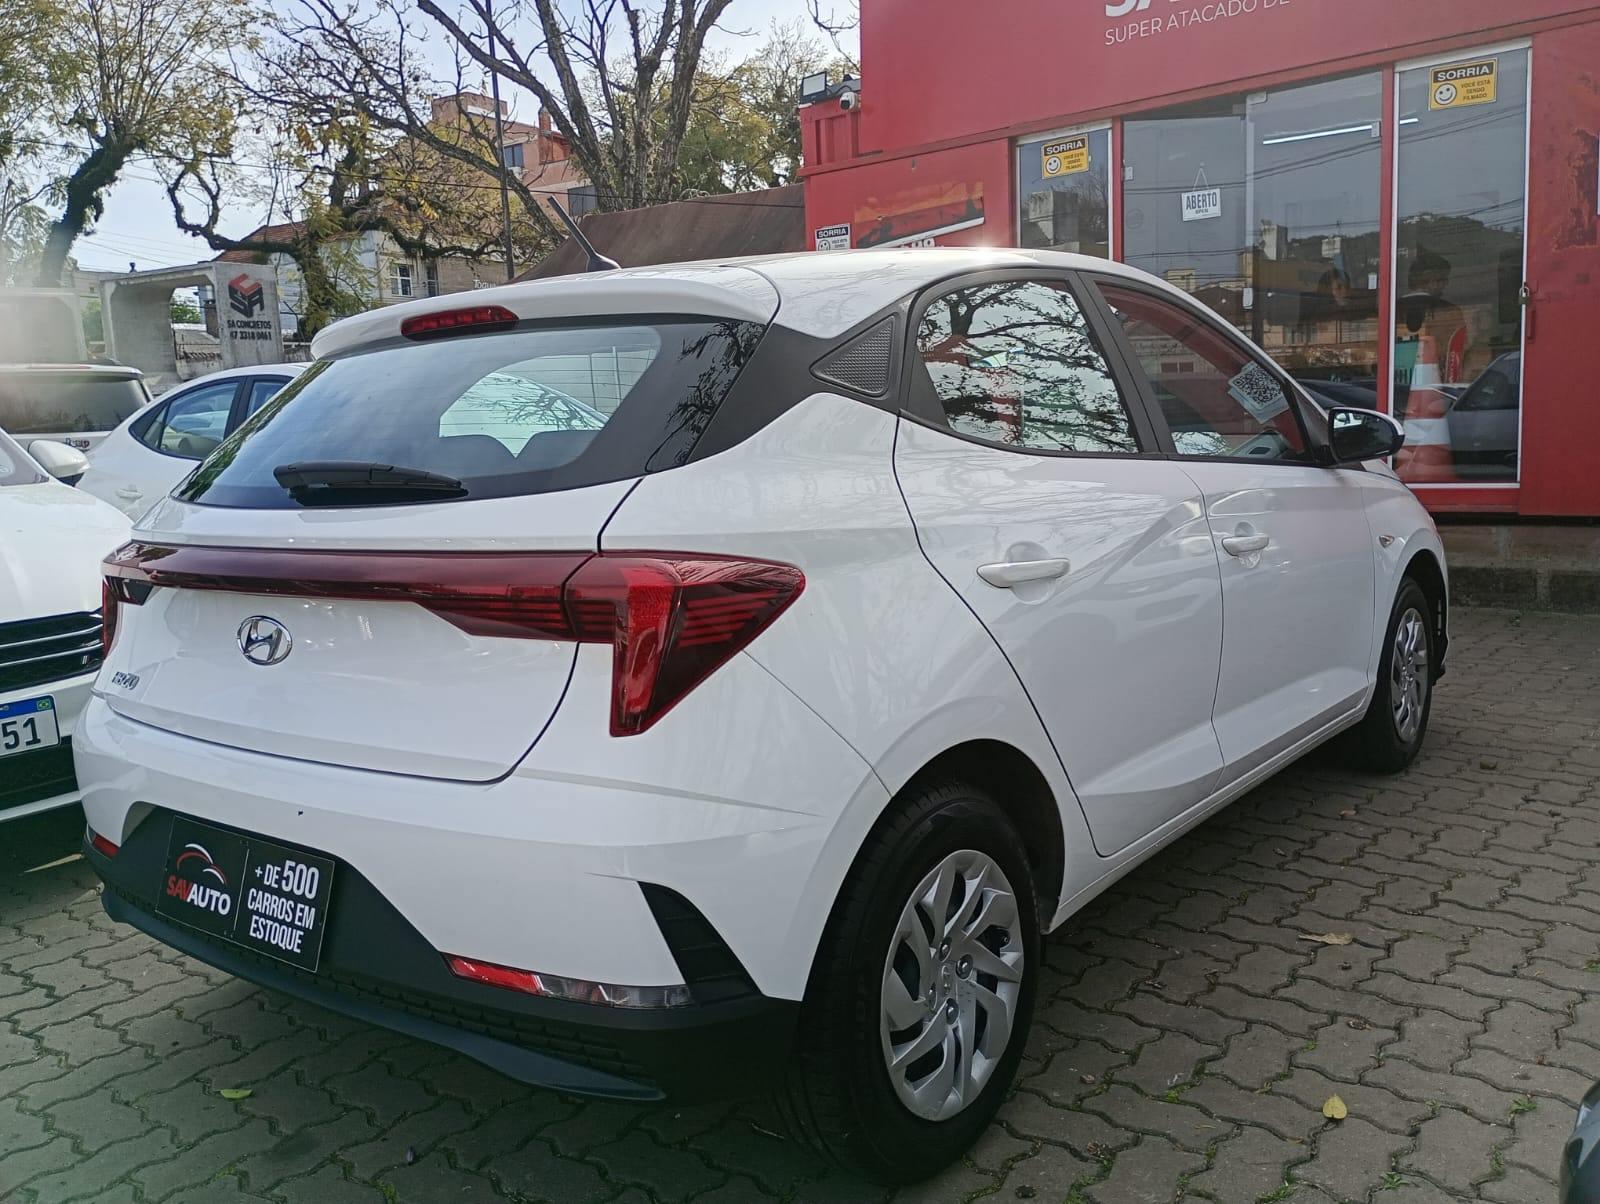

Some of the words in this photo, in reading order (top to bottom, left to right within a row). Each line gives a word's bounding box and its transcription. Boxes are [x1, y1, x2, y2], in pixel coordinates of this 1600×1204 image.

[1105, 18, 1162, 46] SUPER
[1166, 0, 1257, 31] ATACADO
[1263, 0, 1290, 9] D
[1437, 65, 1489, 81] SORRIA
[1046, 140, 1083, 155] SORRIA
[1186, 191, 1217, 210] ABERTO
[818, 228, 847, 238] SORRIA
[236, 320, 272, 330] CONCRETOS
[263, 863, 282, 889] DE
[281, 859, 320, 900] 500
[166, 874, 232, 916] SAVAUTO
[247, 887, 295, 923] CARROS
[294, 902, 317, 930] EM
[249, 914, 305, 954] ESTOQUE
